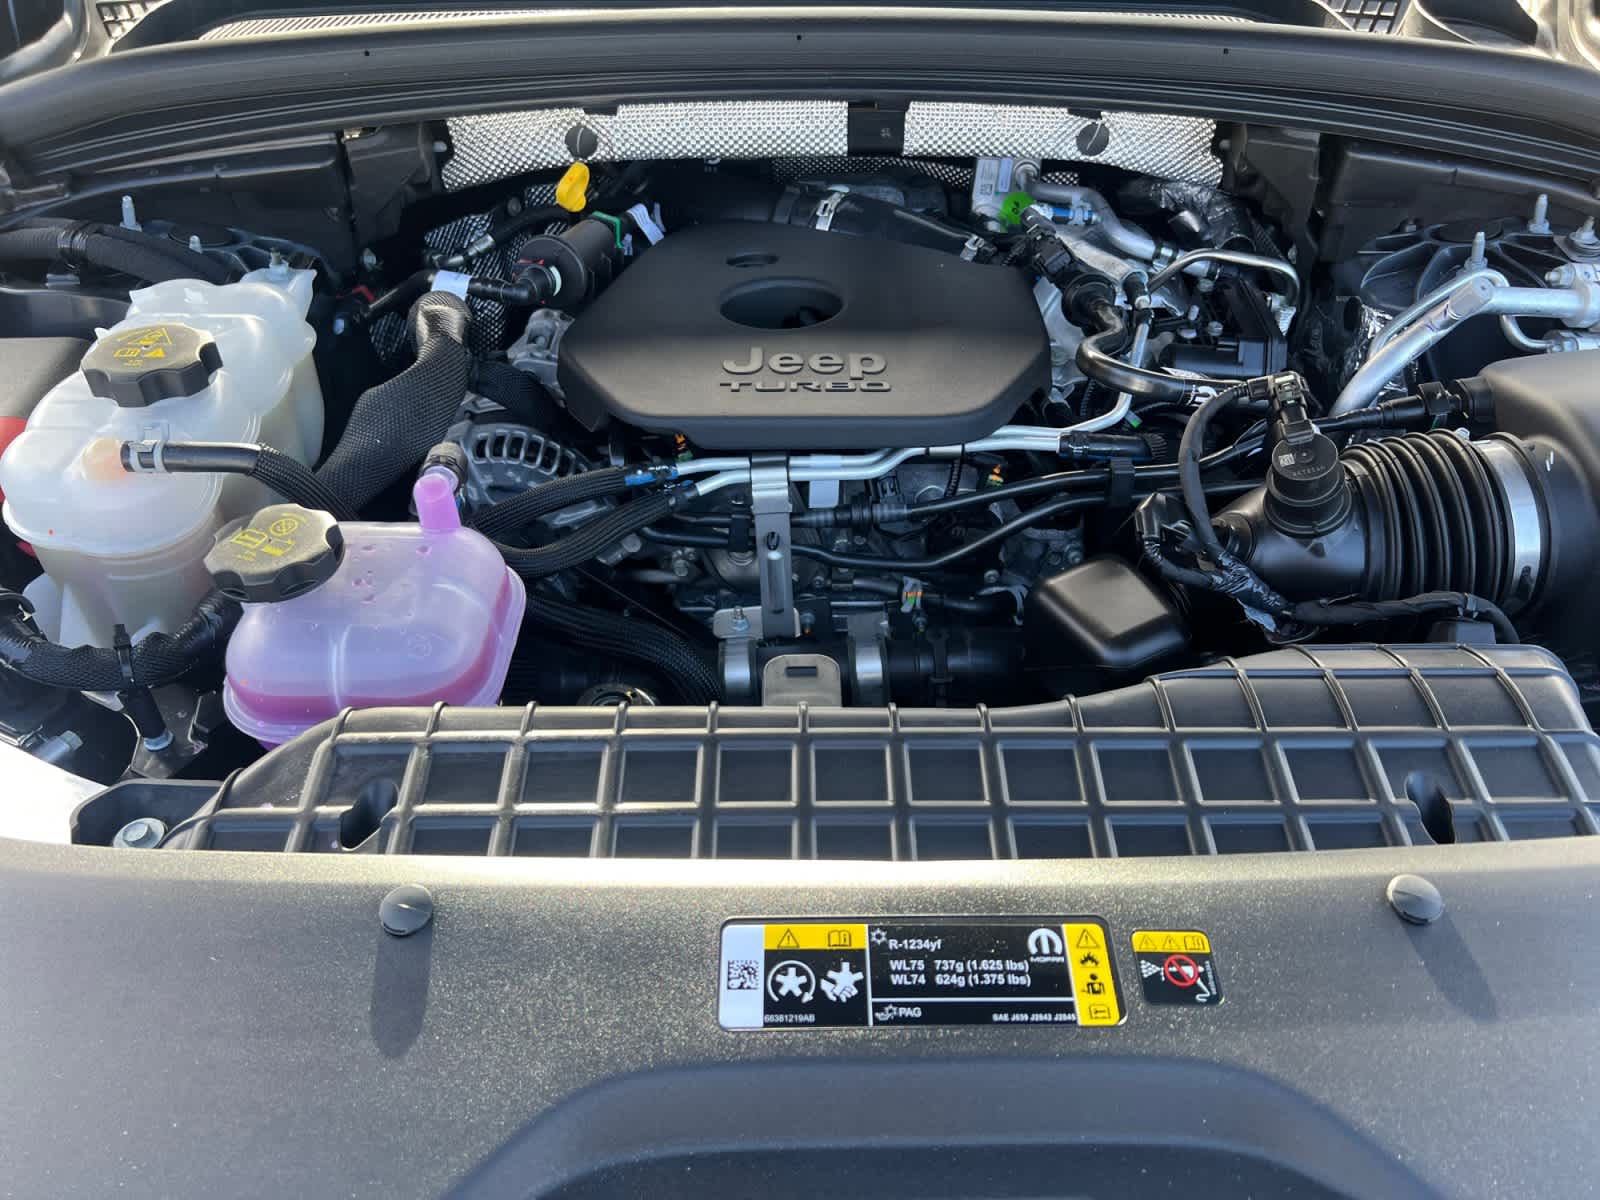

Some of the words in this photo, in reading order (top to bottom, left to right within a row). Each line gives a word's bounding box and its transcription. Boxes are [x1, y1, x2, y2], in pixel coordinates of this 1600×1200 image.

[722, 347, 887, 380] Jeep
[719, 381, 892, 392] TURBO
[888, 938, 942, 952] R-1234yf
[890, 959, 925, 971] WL75
[934, 959, 964, 973] 737g
[967, 959, 1003, 973] (1.625
[1005, 959, 1030, 973] lbs)
[890, 974, 926, 985] WL74
[935, 974, 966, 987] 624g
[968, 974, 1005, 987] (1.375
[1007, 974, 1032, 987] lbs)
[898, 1006, 922, 1018] PAG
